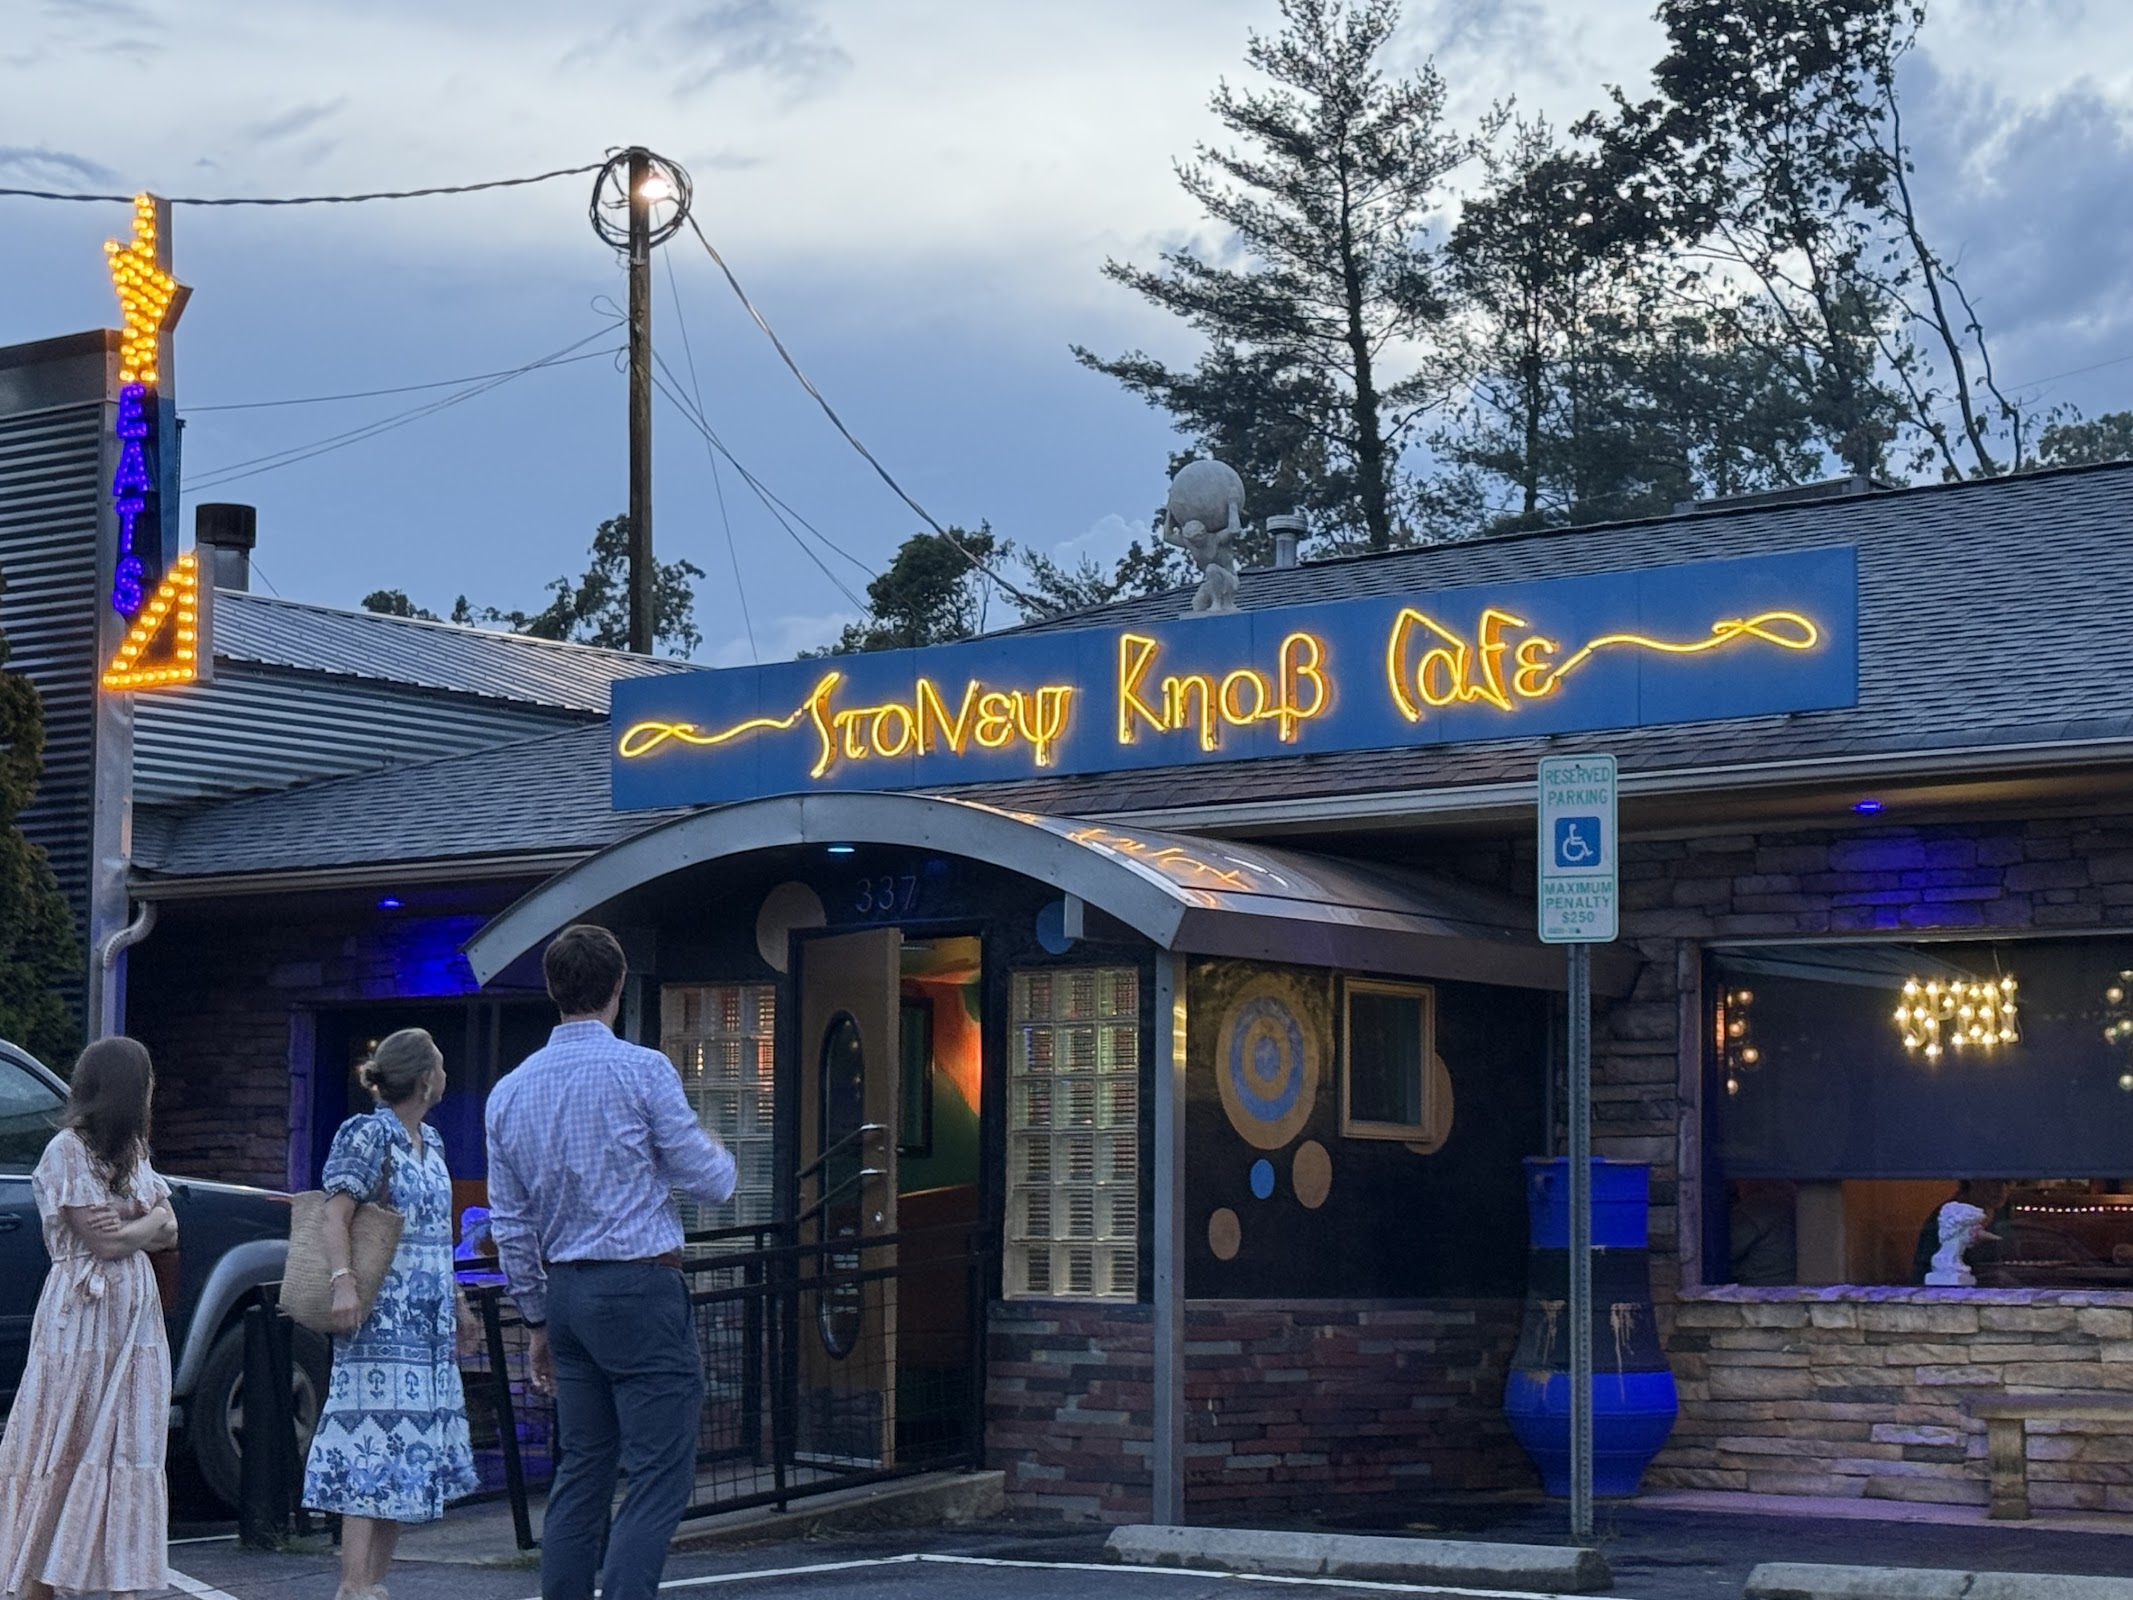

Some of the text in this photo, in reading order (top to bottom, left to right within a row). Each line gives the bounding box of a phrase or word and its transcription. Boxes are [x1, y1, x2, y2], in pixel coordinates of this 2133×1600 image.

[113, 382, 148, 616] EATS
[1545, 766, 1610, 786] RESERVED
[1547, 788, 1608, 806] PARKING
[856, 875, 917, 913] 337
[1544, 881, 1612, 895] MAXIMUM
[1545, 896, 1610, 910] PENALTY
[1562, 911, 1595, 924] $250
[1895, 977, 2019, 1055] OPEN
